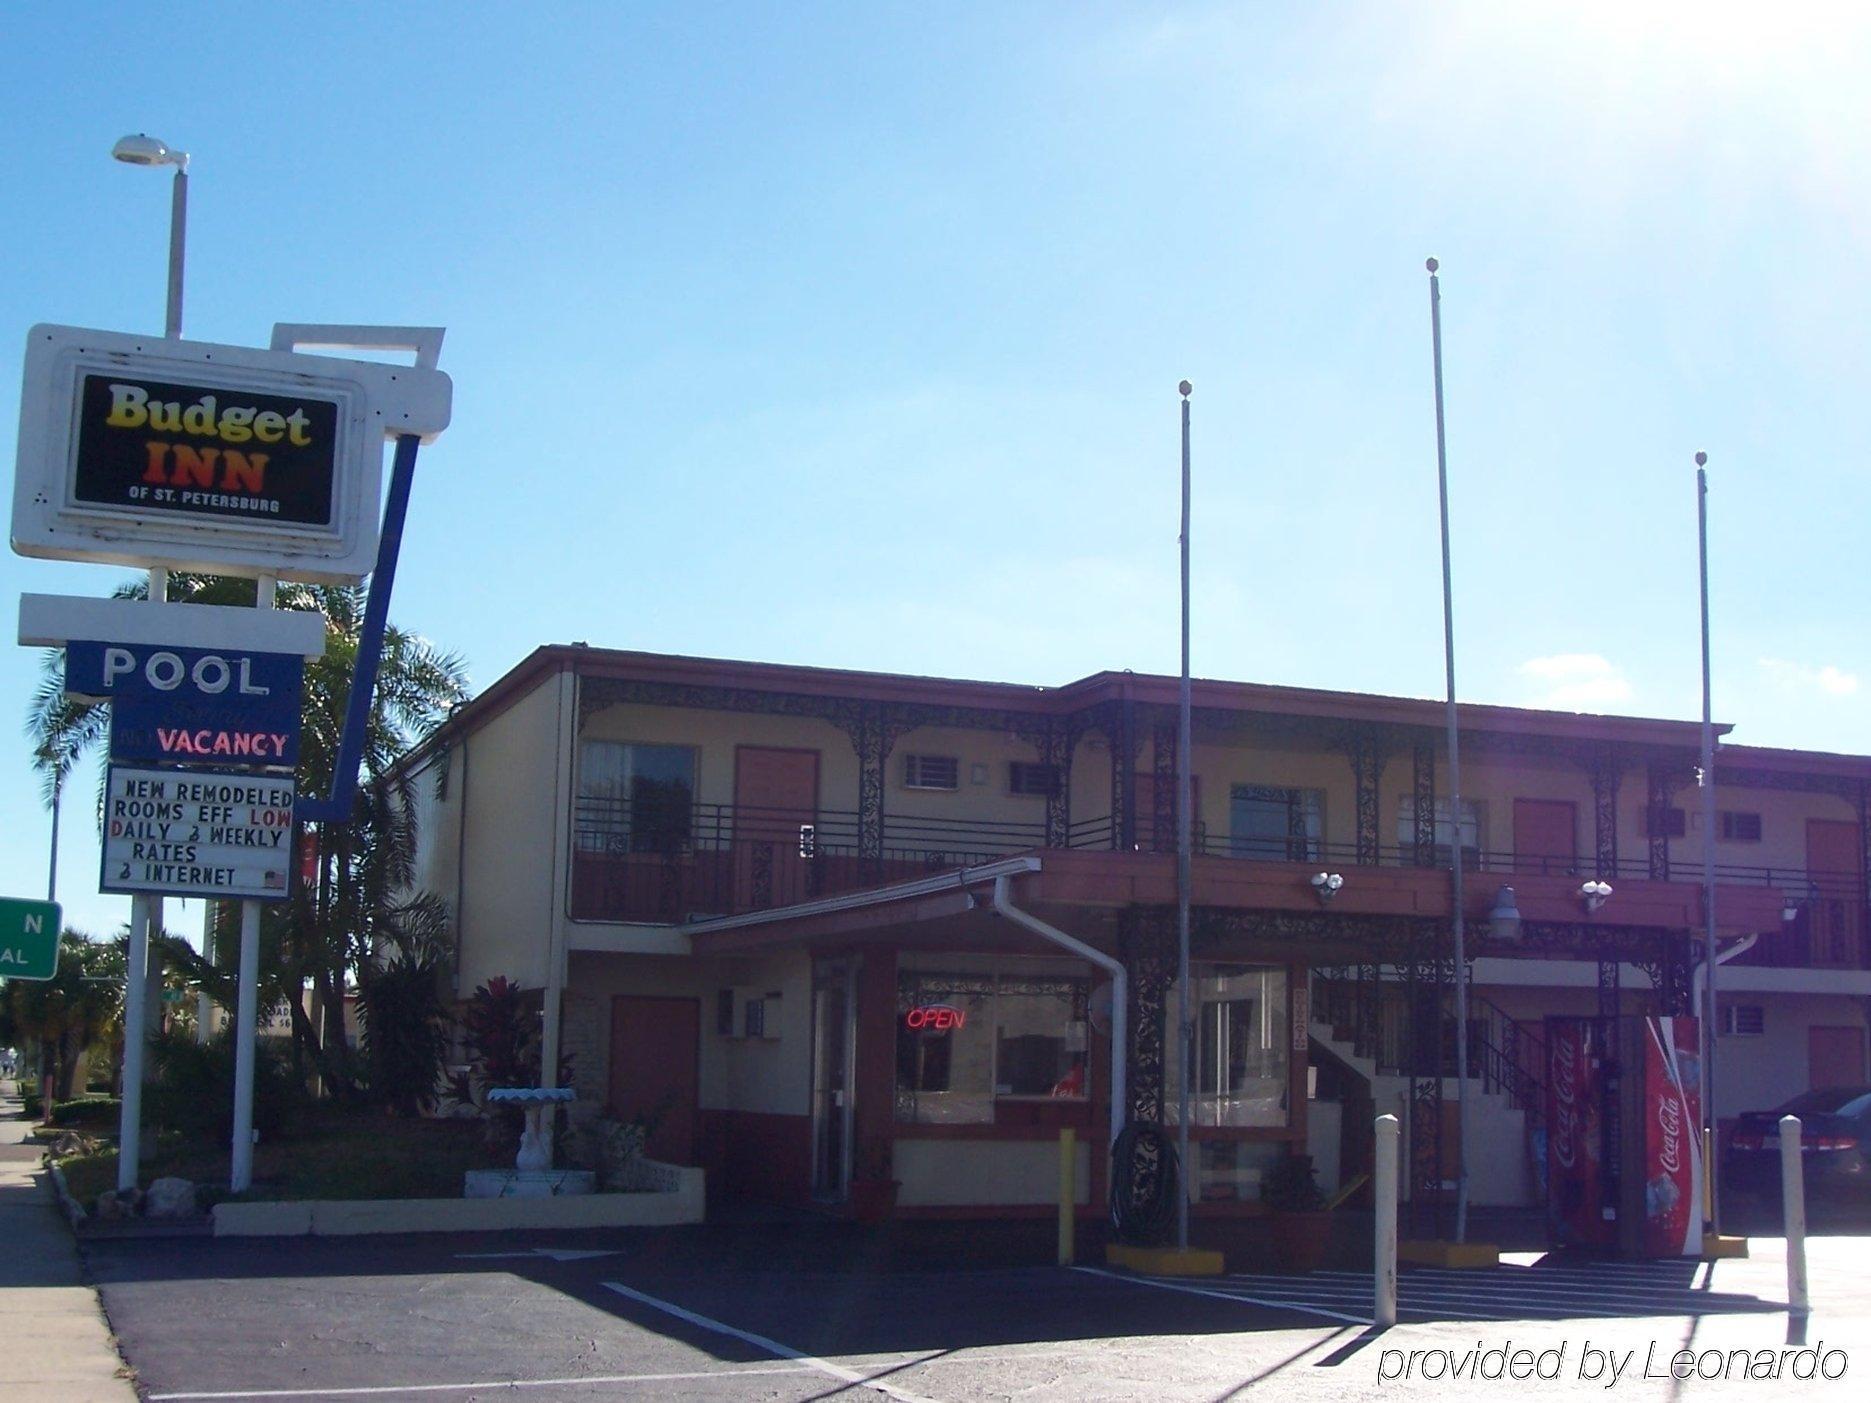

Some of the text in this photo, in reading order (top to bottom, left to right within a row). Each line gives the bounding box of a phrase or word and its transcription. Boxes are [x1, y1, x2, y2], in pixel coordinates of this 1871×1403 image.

[106, 384, 312, 446] Budget
[142, 440, 270, 493] INN
[129, 486, 280, 513] OF ST. PETERSBURG
[103, 648, 270, 696] POOL
[156, 728, 290, 757] VACANCY
[126, 780, 292, 808] NEW REMODELED
[115, 800, 291, 827] ROOMS EFF LOW
[111, 820, 171, 840] DAILY
[210, 827, 283, 847] WEEKLY
[133, 843, 196, 862] RATES
[145, 863, 235, 886] INTERNET
[23, 913, 42, 934] N
[908, 1009, 965, 1029] OPEN
